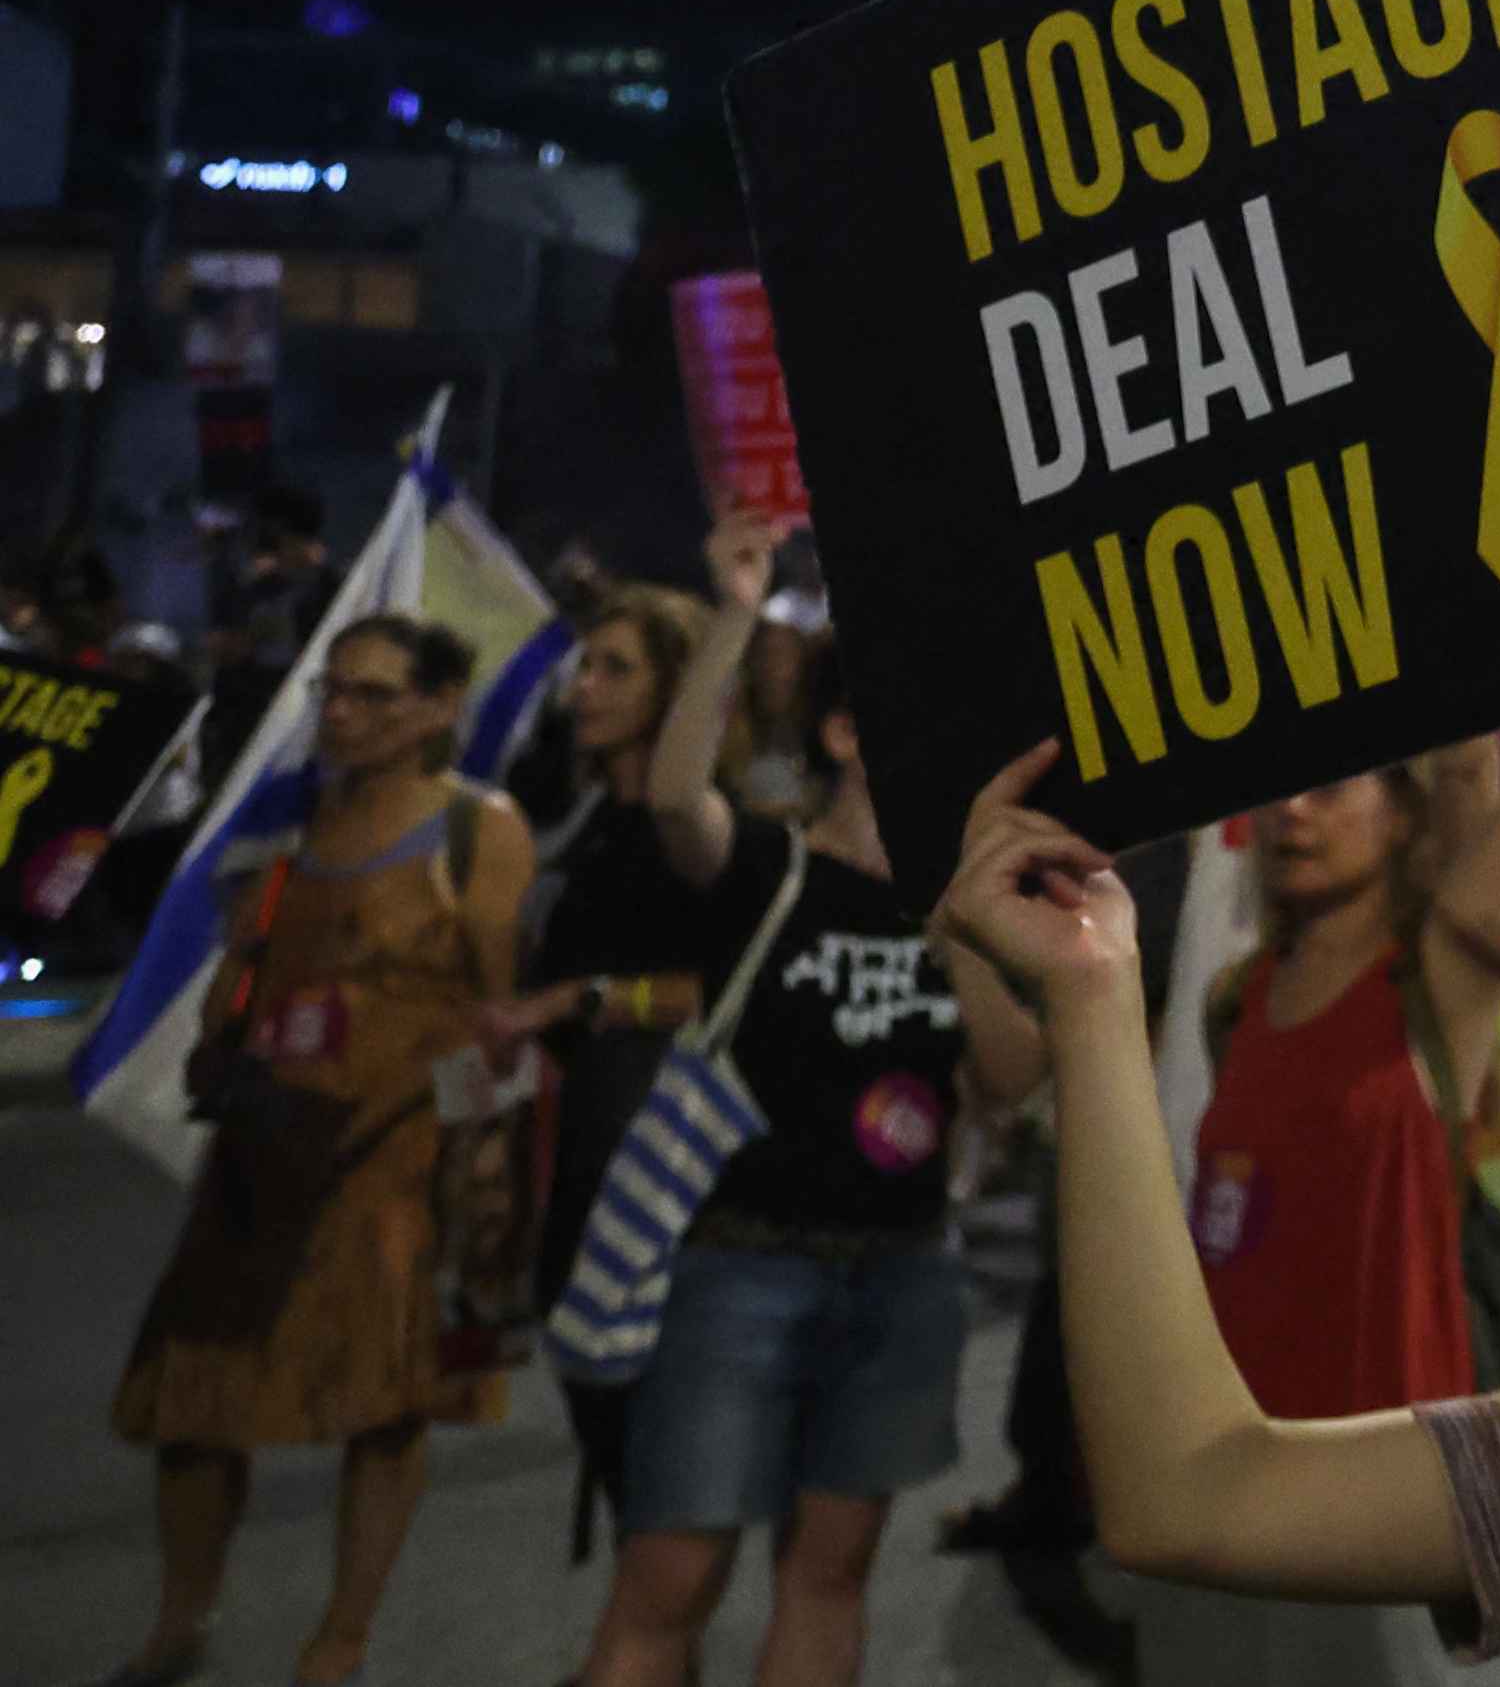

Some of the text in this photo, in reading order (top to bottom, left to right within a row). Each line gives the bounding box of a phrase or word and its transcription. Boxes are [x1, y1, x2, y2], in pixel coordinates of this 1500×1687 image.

[980, 194, 1354, 506] DEAL
[0, 665, 119, 751] TAGE
[1034, 443, 1398, 785] NOW
